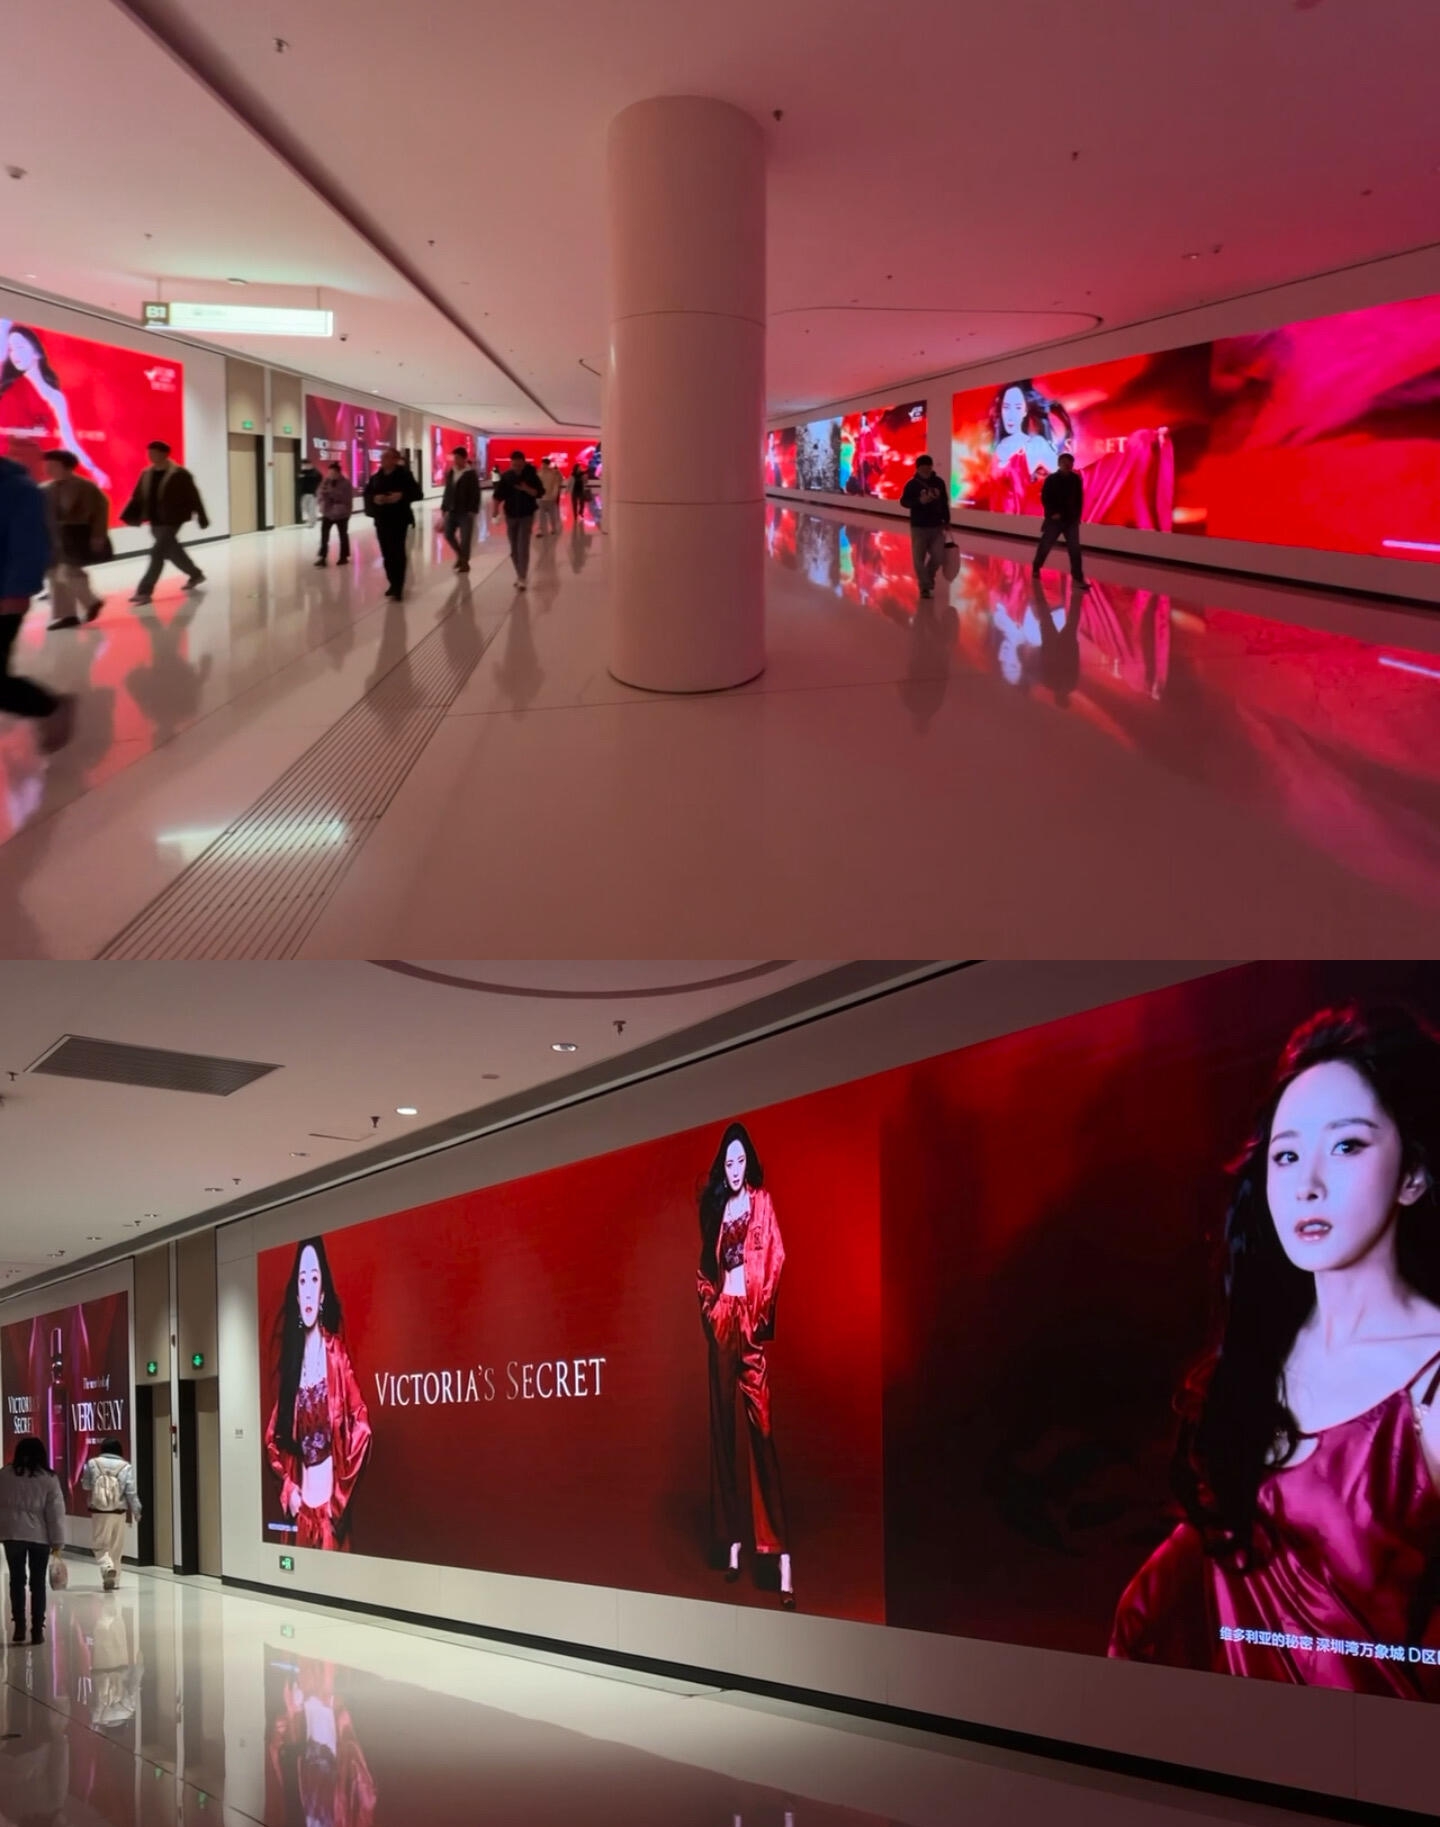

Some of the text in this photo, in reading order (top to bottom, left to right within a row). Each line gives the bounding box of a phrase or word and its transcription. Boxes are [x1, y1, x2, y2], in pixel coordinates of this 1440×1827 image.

[375, 1357, 606, 1406] VICTORIA'S SECRET
[71, 1399, 124, 1432] VERY SEXY
[1219, 1626, 1440, 1667] 维多利亚的秘密 深圳湾万象城 D区
